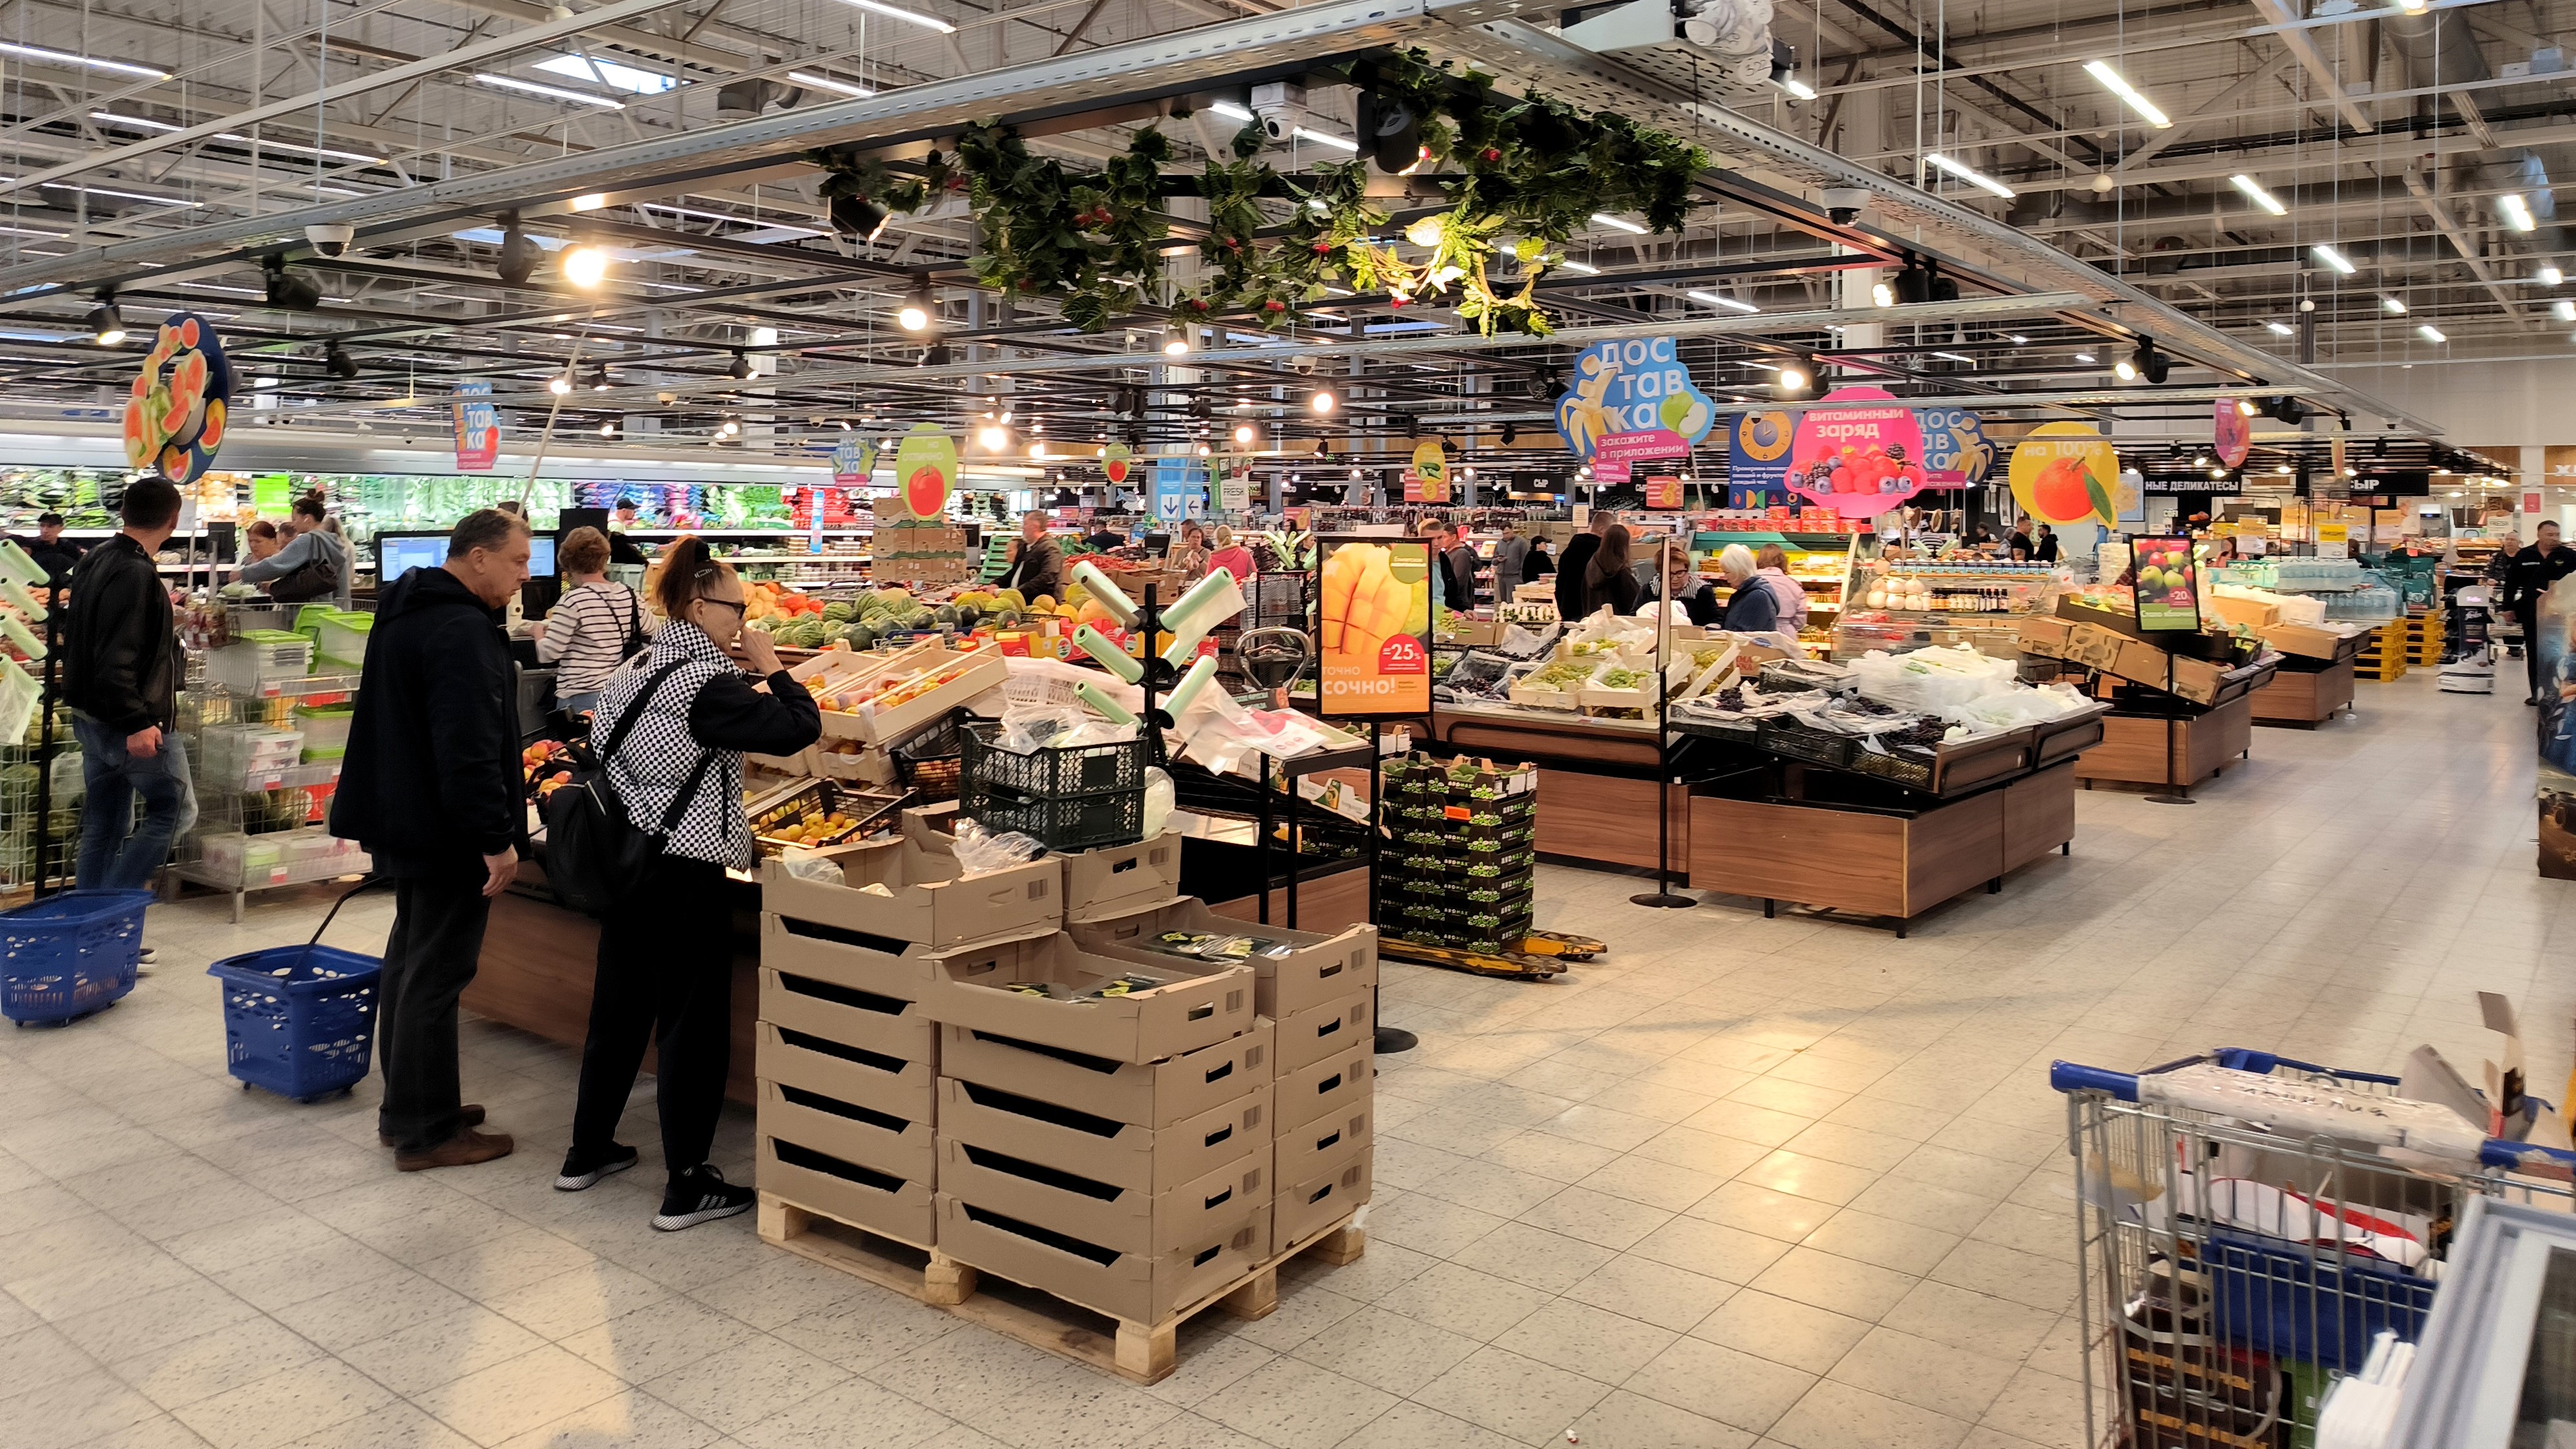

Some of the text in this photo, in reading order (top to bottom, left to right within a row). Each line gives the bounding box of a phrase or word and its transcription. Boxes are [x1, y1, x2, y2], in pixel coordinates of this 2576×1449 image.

[1600, 337, 1670, 373] дос
[1618, 370, 1684, 400] тав
[467, 410, 492, 428] тав
[1611, 402, 1657, 430] ка
[466, 431, 486, 449] ка
[1600, 434, 1656, 447] закажите
[1816, 423, 1880, 443] заряд
[1923, 433, 1950, 450] ав
[1600, 444, 1684, 461] в приложении
[2024, 441, 2104, 457] на 100%
[2145, 481, 2239, 492] НЫЕ ДЕЛИКАТЕСЫ
